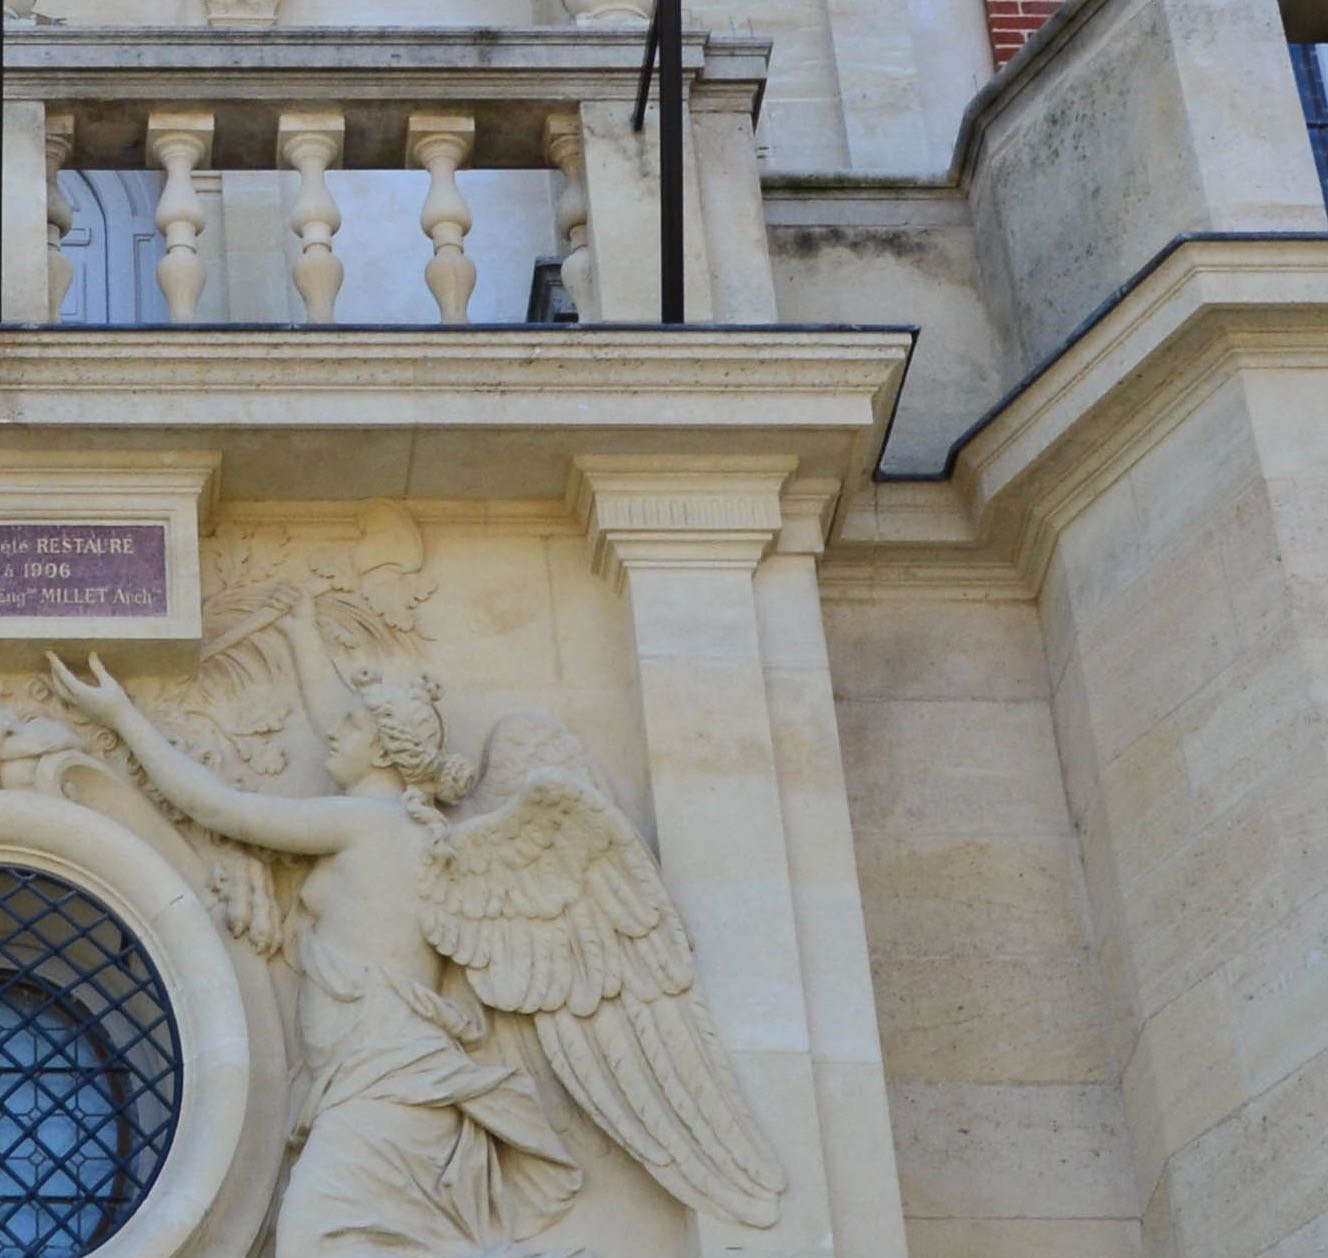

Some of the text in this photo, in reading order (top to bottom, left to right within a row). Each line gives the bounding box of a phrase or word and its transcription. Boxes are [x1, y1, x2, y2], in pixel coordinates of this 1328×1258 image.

[37, 534, 134, 555] RESTAURÉ
[23, 562, 71, 579] 1906
[40, 587, 109, 604] MILLET
